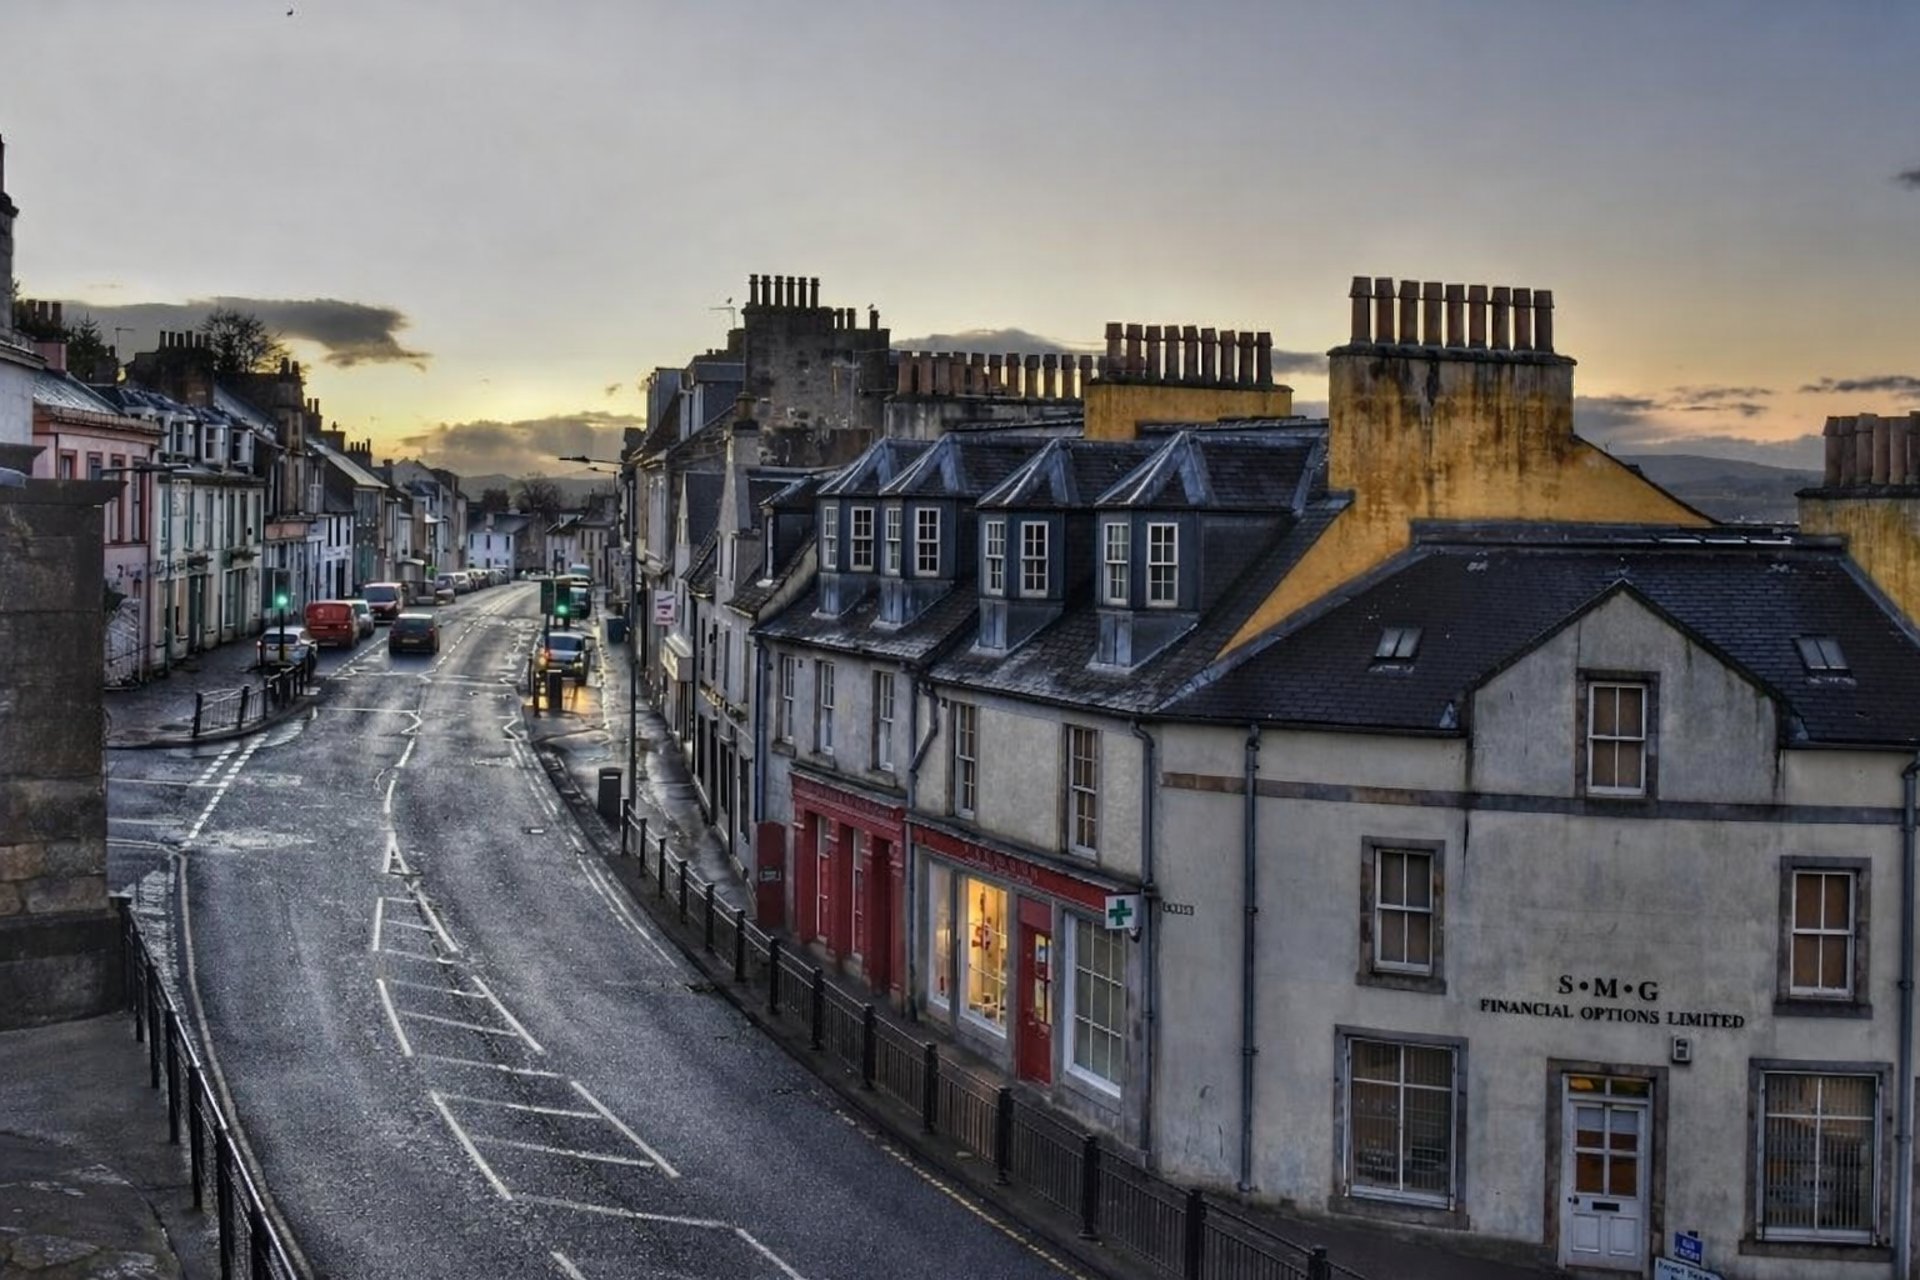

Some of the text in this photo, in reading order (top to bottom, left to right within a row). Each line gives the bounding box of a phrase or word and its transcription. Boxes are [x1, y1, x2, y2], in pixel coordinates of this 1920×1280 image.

[1480, 998, 1745, 1029] FINANCIAL OPTIONS LIMITED
